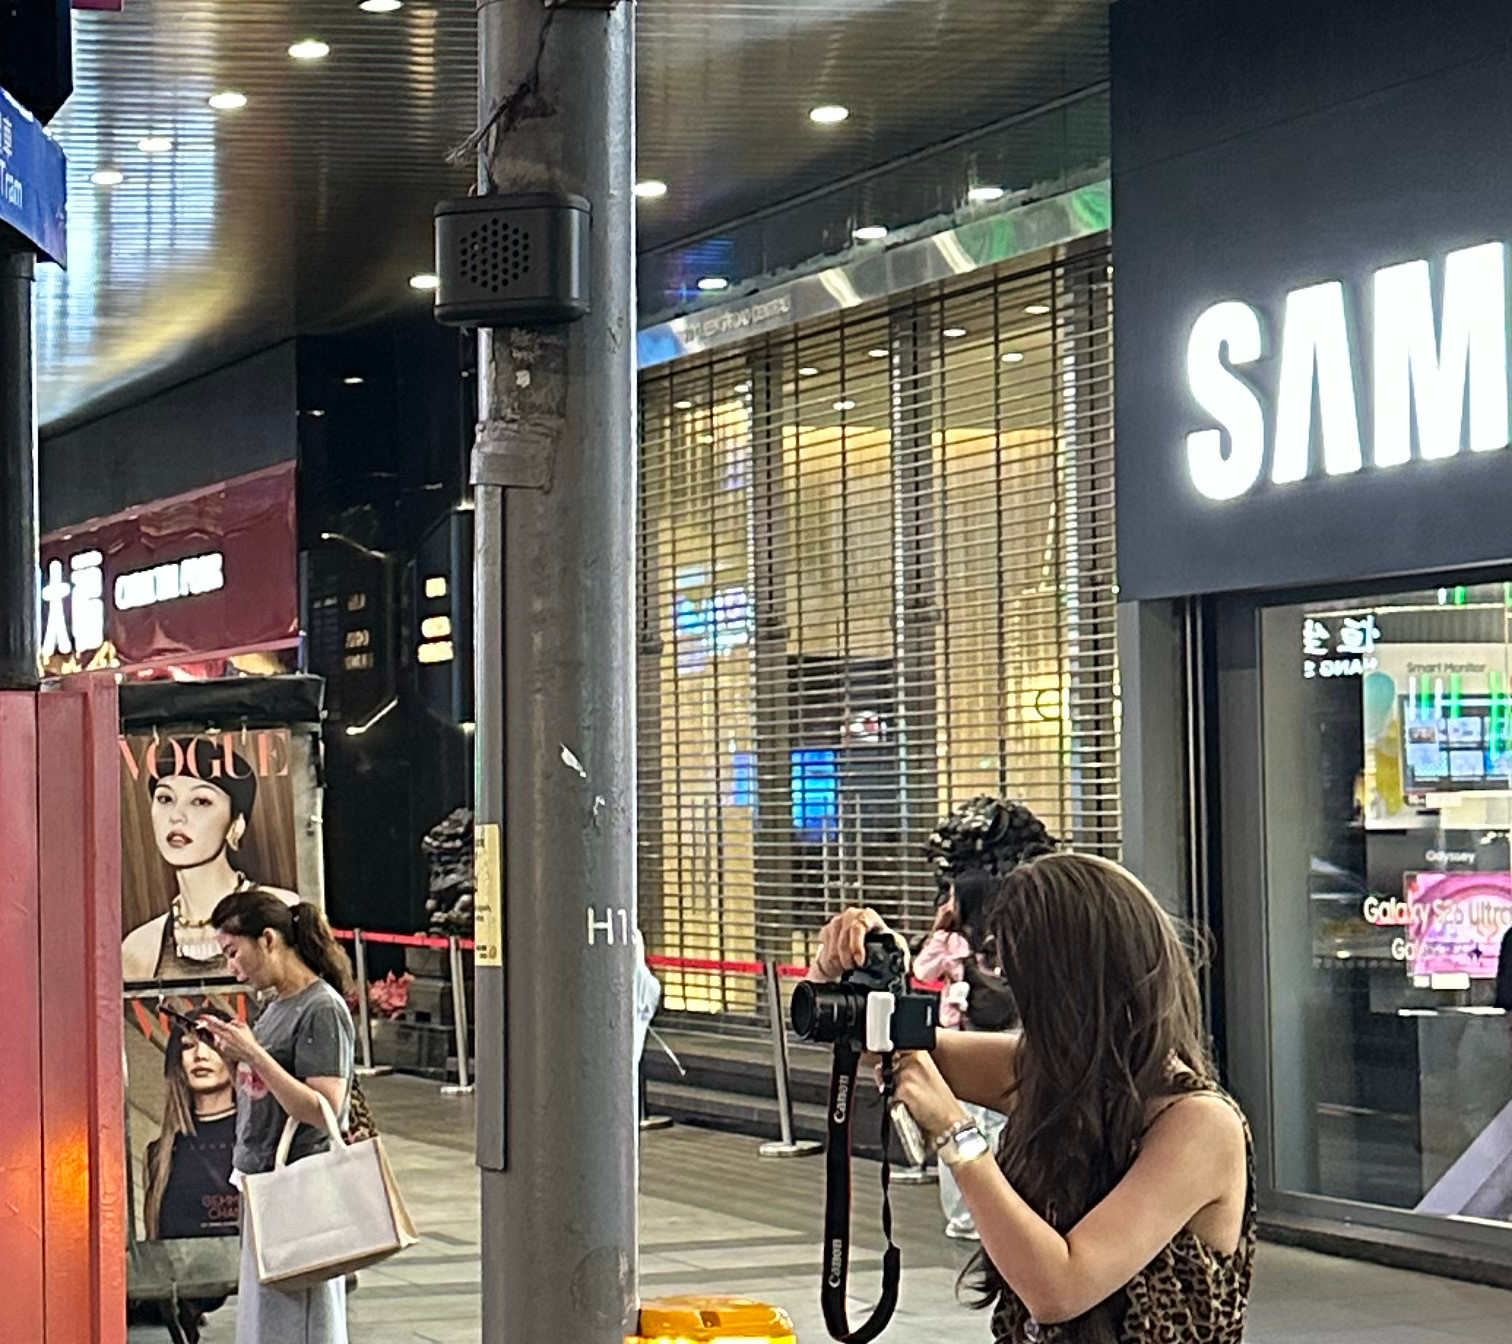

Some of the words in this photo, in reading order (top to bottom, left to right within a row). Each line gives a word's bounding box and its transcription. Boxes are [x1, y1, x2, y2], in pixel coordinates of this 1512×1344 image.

[1187, 240, 1509, 501] SAM
[1406, 662, 1441, 673] Smart
[1444, 662, 1486, 673] Monitor
[119, 730, 289, 780] VOGUE
[1425, 850, 1475, 864] Odyssey
[833, 1074, 850, 1124] Canon
[829, 1239, 842, 1288] Canon
